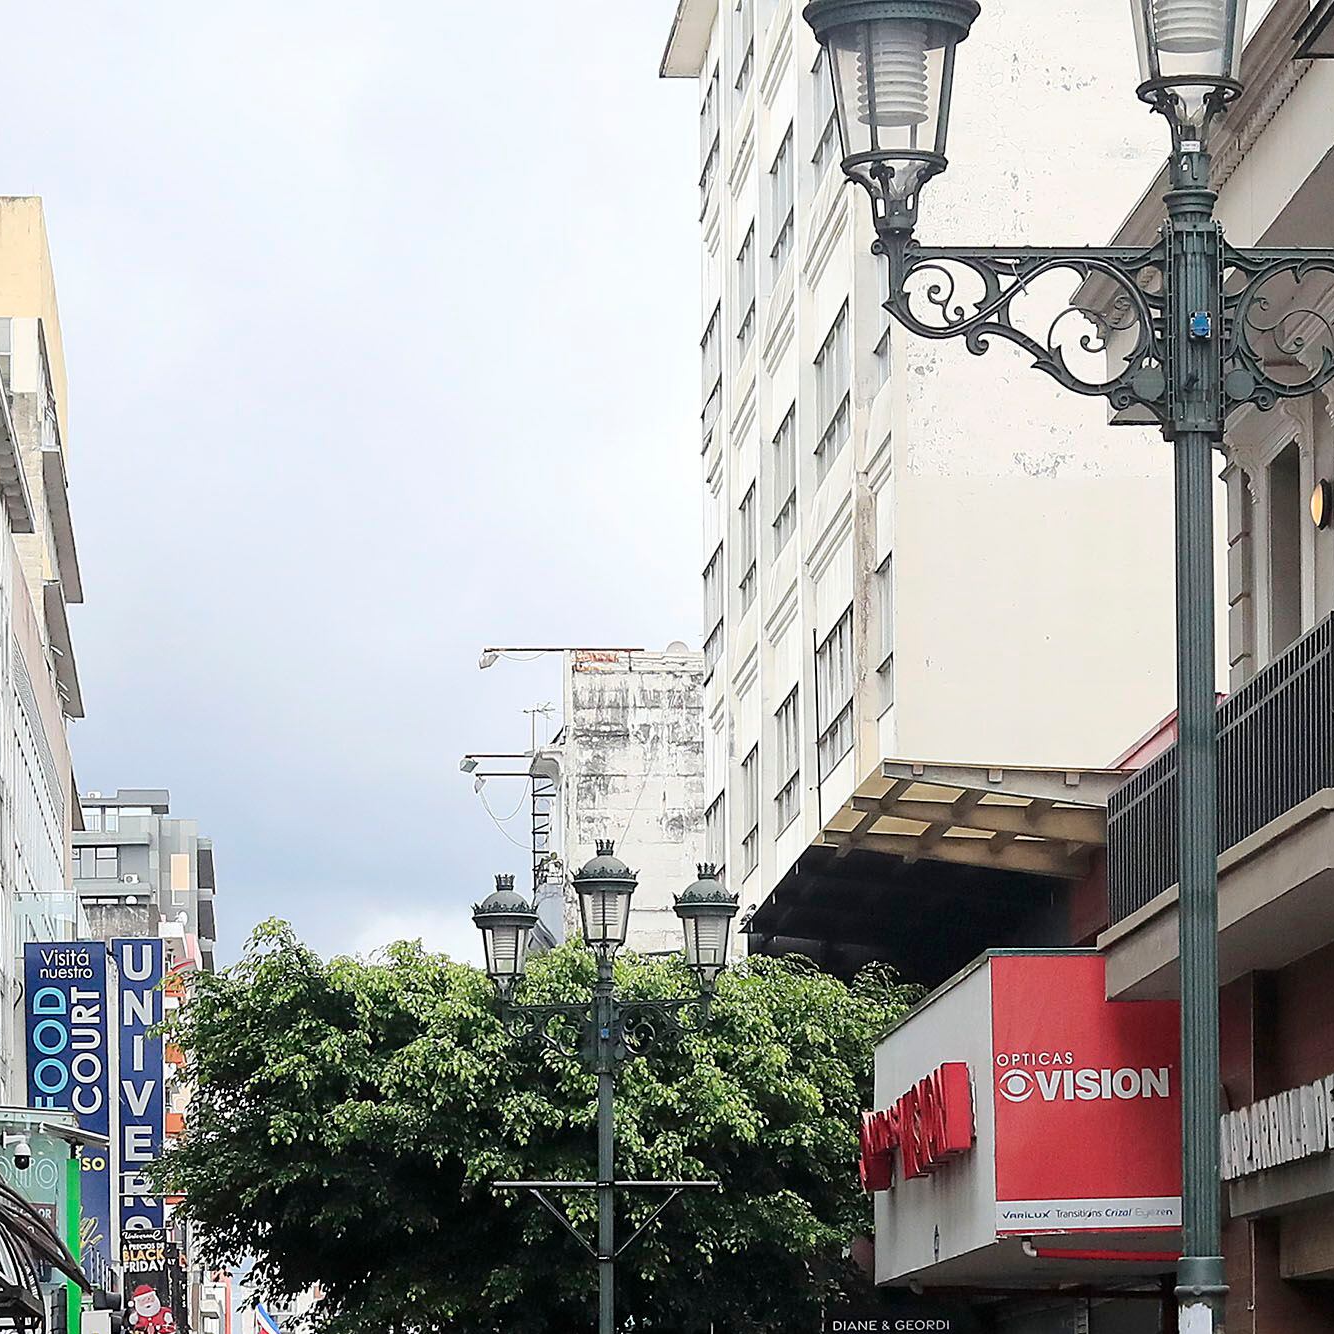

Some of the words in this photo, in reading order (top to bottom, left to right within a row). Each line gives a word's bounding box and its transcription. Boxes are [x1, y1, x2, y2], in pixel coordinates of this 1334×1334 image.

[40, 948, 91, 967] Visitá
[40, 966, 94, 980] nuestro
[33, 986, 69, 1111] FOOD
[70, 986, 103, 1115] COURT
[997, 1051, 1074, 1067] OPTICAS
[1035, 1067, 1169, 1101] VISION
[1104, 1208, 1132, 1218] Crizal
[122, 1248, 166, 1263] BLACK
[123, 1259, 167, 1274] FRIDAY
[832, 1320, 878, 1331] DIANE
[881, 1320, 890, 1331] &
[894, 1319, 950, 1331] GEORDI
